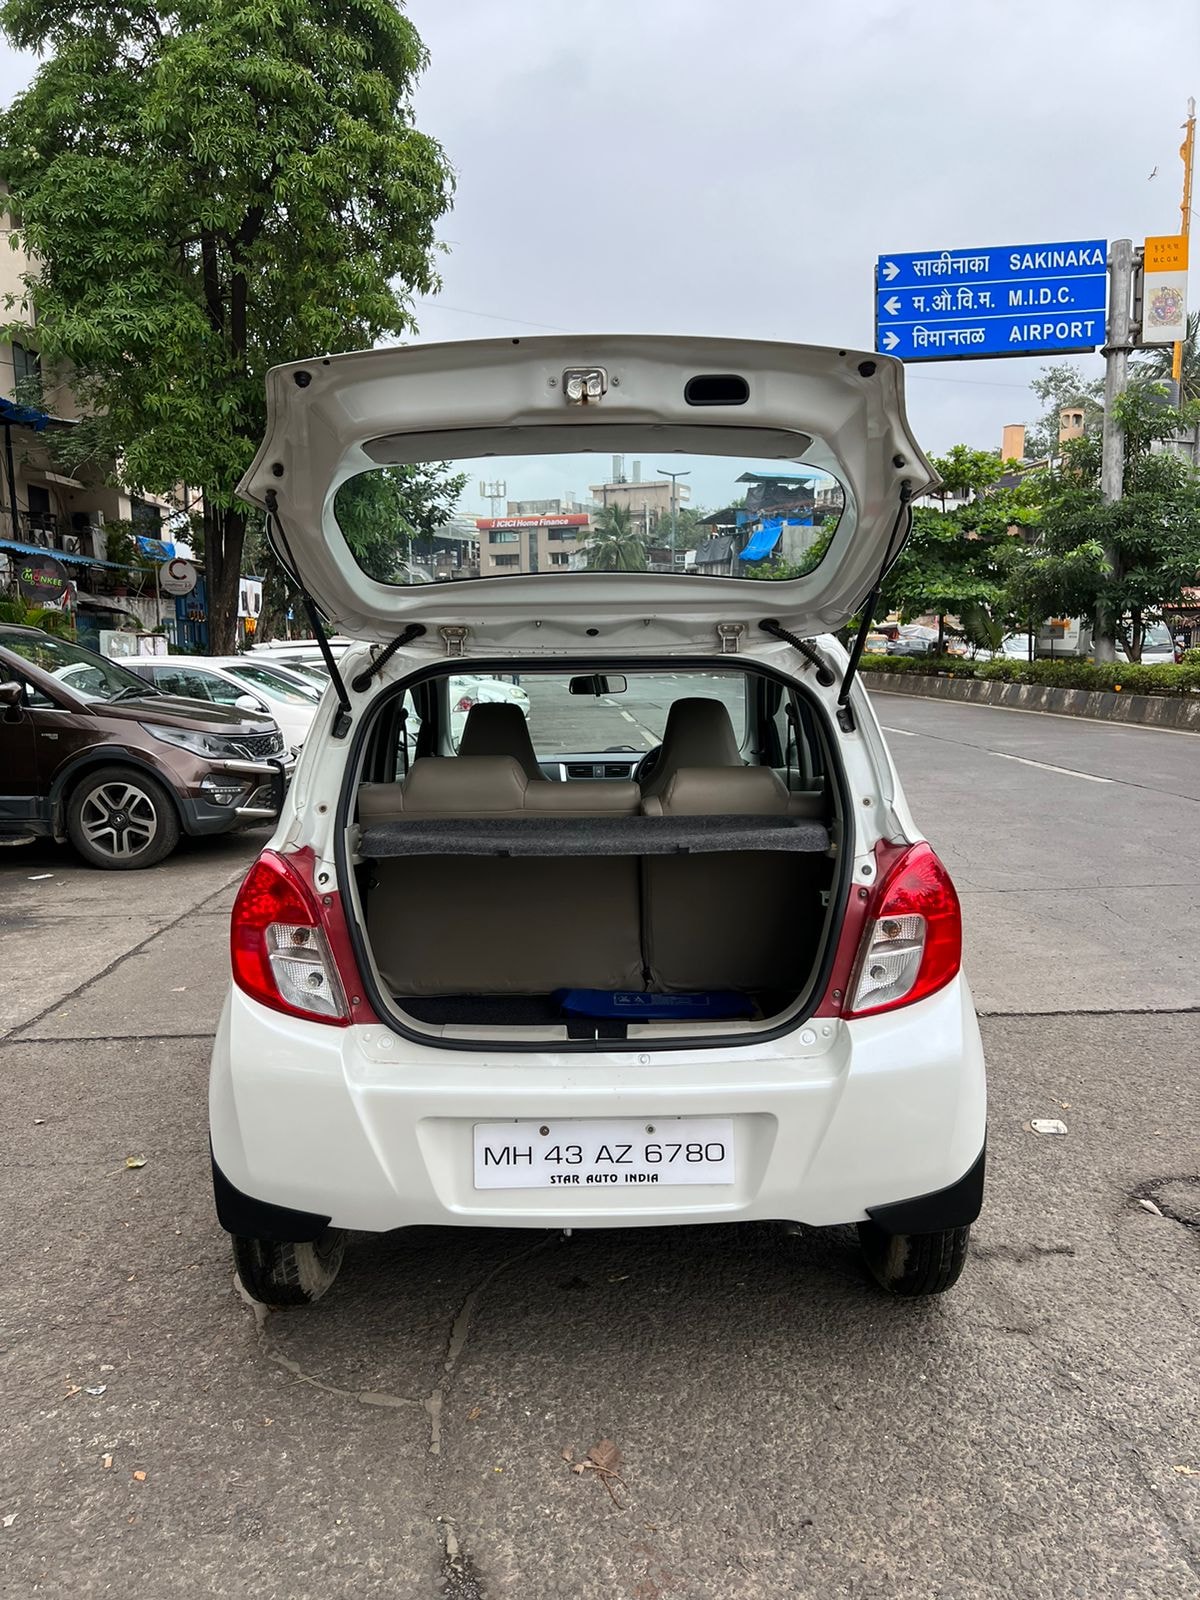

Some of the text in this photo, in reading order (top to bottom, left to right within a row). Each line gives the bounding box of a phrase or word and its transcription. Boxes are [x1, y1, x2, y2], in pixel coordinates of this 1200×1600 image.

[912, 252, 990, 277] साकीनाका
[1009, 248, 1105, 271] SAKINAKA
[912, 287, 996, 313] म.औ.वि.म.
[1008, 287, 1075, 307] M.I.D.C.
[911, 325, 986, 348] विमानतळ
[1008, 321, 1096, 343] AIRPORT
[496, 520, 516, 528] ICICI
[539, 518, 569, 526] Finance
[484, 1142, 726, 1166] MH 43 AZ 6780
[550, 1173, 659, 1184] STAR AUTO INDIA
